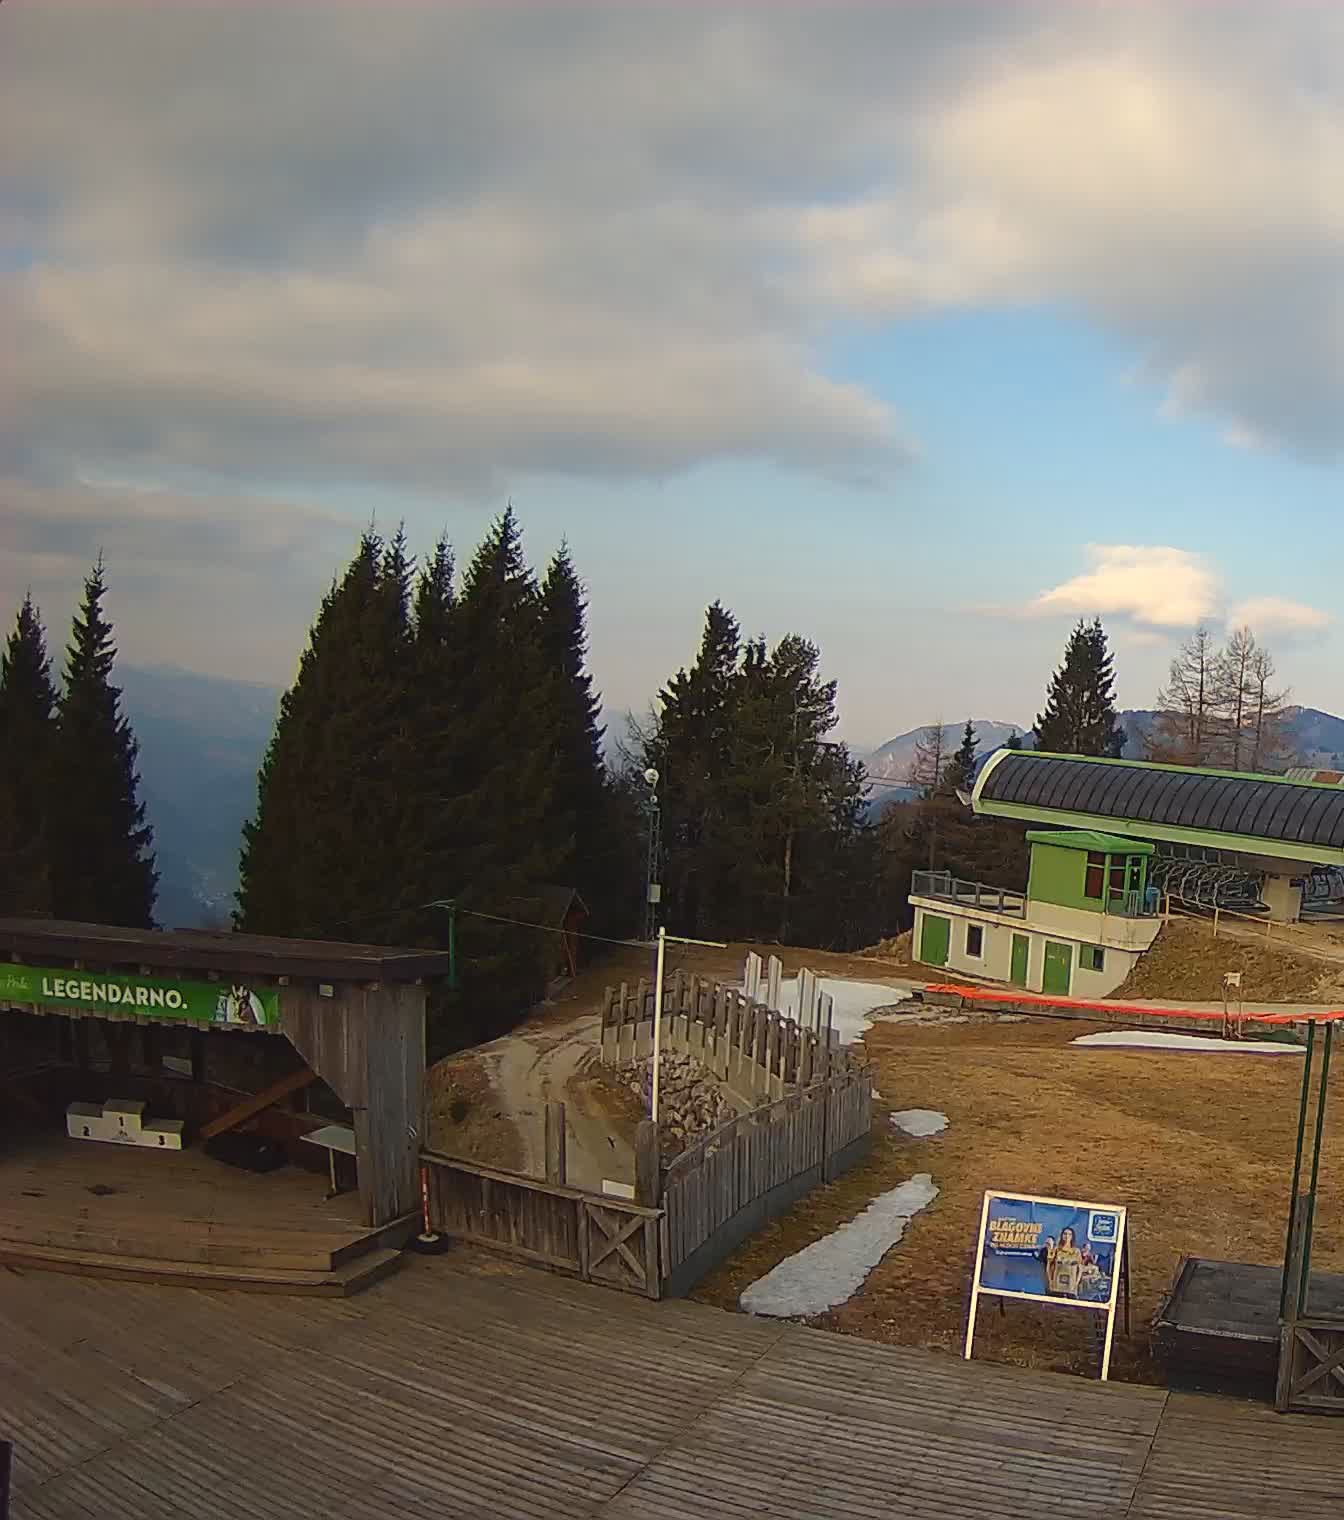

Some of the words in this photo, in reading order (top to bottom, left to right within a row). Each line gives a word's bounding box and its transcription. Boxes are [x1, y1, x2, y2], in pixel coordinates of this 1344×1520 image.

[42, 977, 188, 1009] LEGENDARNO.
[83, 1126, 90, 1137] 2
[159, 1135, 165, 1146] 3
